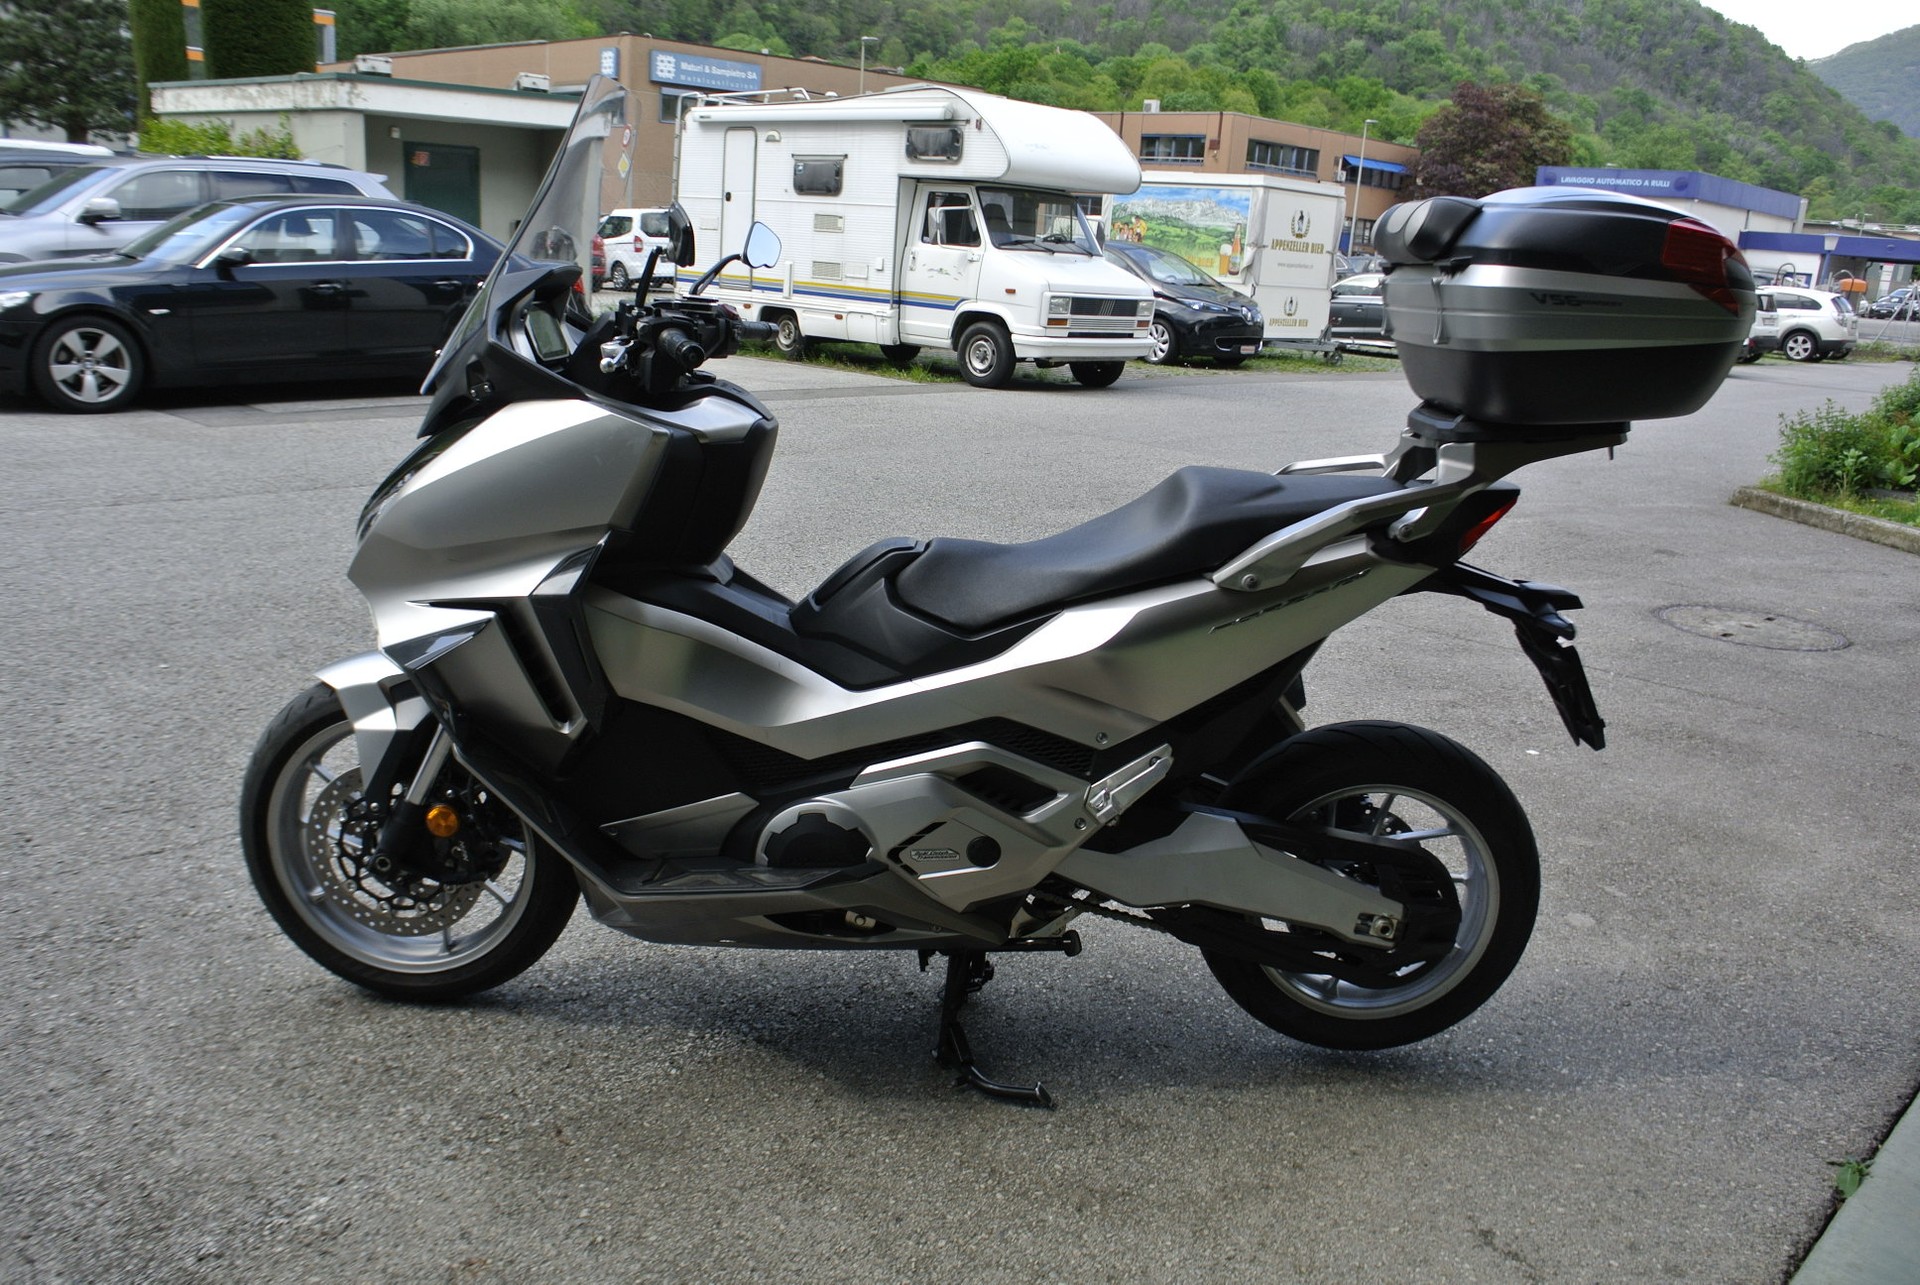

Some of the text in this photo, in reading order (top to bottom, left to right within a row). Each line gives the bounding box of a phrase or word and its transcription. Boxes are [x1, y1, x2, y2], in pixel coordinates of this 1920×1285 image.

[704, 65, 710, 73] &
[746, 71, 757, 79] SA
[1560, 176, 1595, 185] LAVAGGIO
[1596, 177, 1642, 187] AUTOMATICO
[1650, 180, 1671, 188] RULLI
[1271, 238, 1324, 254] APPENZELLER BIER
[1269, 318, 1308, 327] APPENZELLER BIER
